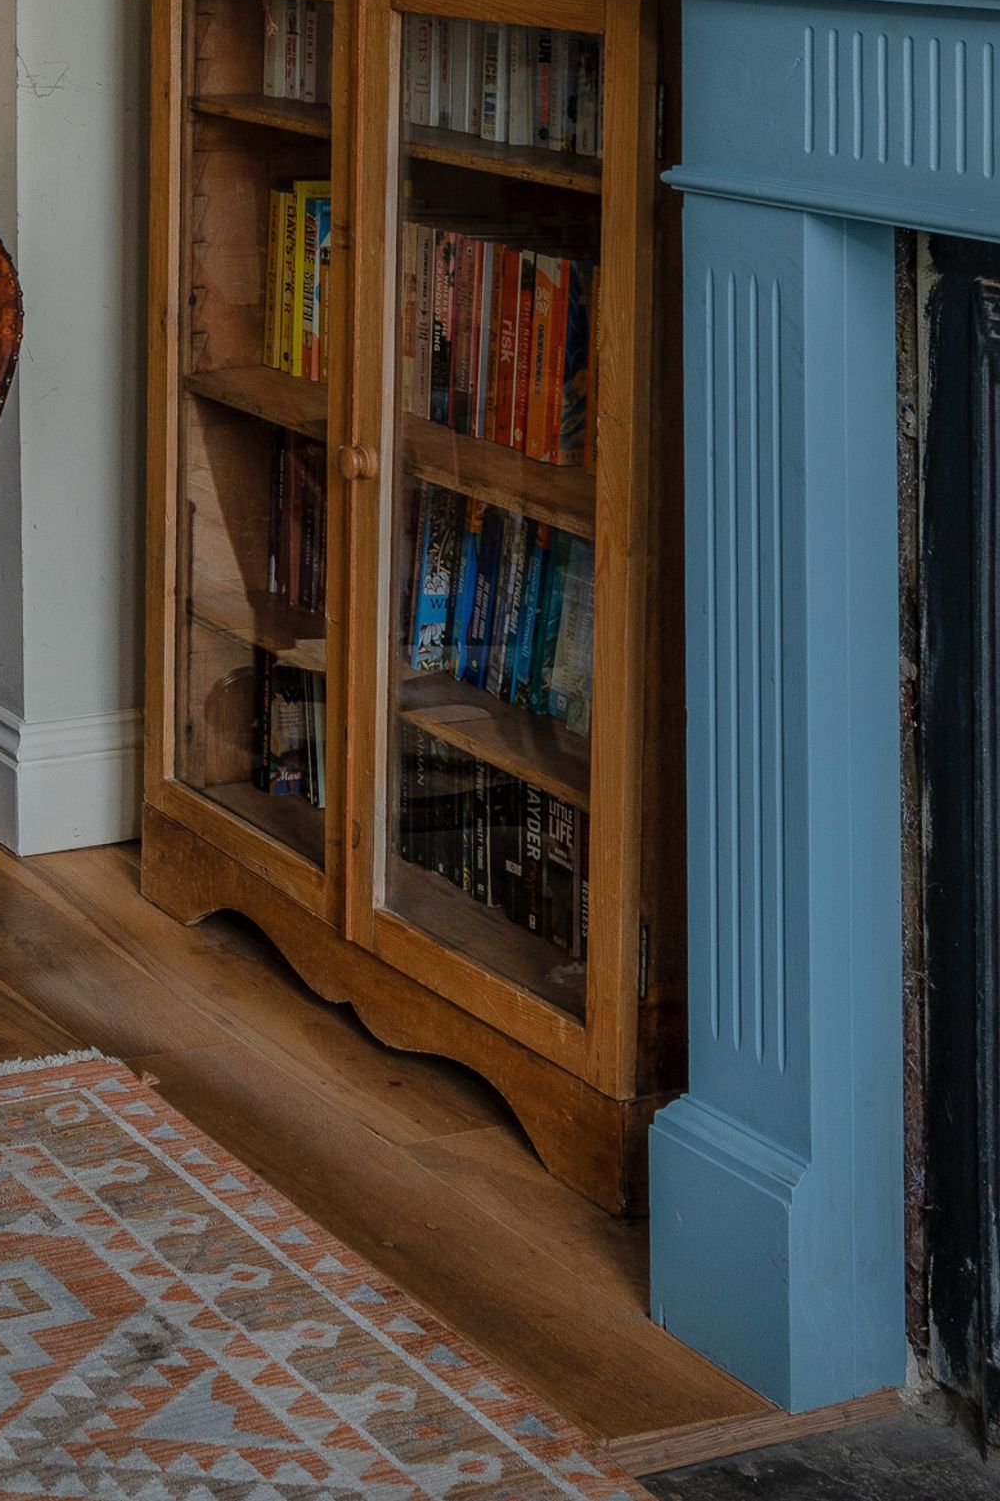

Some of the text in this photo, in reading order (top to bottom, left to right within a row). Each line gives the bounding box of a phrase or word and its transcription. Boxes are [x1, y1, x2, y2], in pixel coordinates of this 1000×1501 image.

[482, 33, 499, 135] BRICK LANE
[286, 205, 298, 255] LIAR'S
[433, 260, 444, 352] CRAWDADS SING
[441, 274, 450, 338] WHERE THE
[500, 318, 514, 365] risk
[520, 328, 531, 389] RIPENING
[519, 390, 527, 416] SUN
[457, 557, 467, 595] Berlin
[529, 557, 541, 592] Devon
[510, 572, 523, 635] ENGLISH
[520, 605, 534, 659] Cornwall
[548, 799, 575, 826] LITTLE
[548, 815, 574, 850] LIFE
[476, 845, 484, 871] YOUNG
[581, 880, 590, 938] RESTLESS
